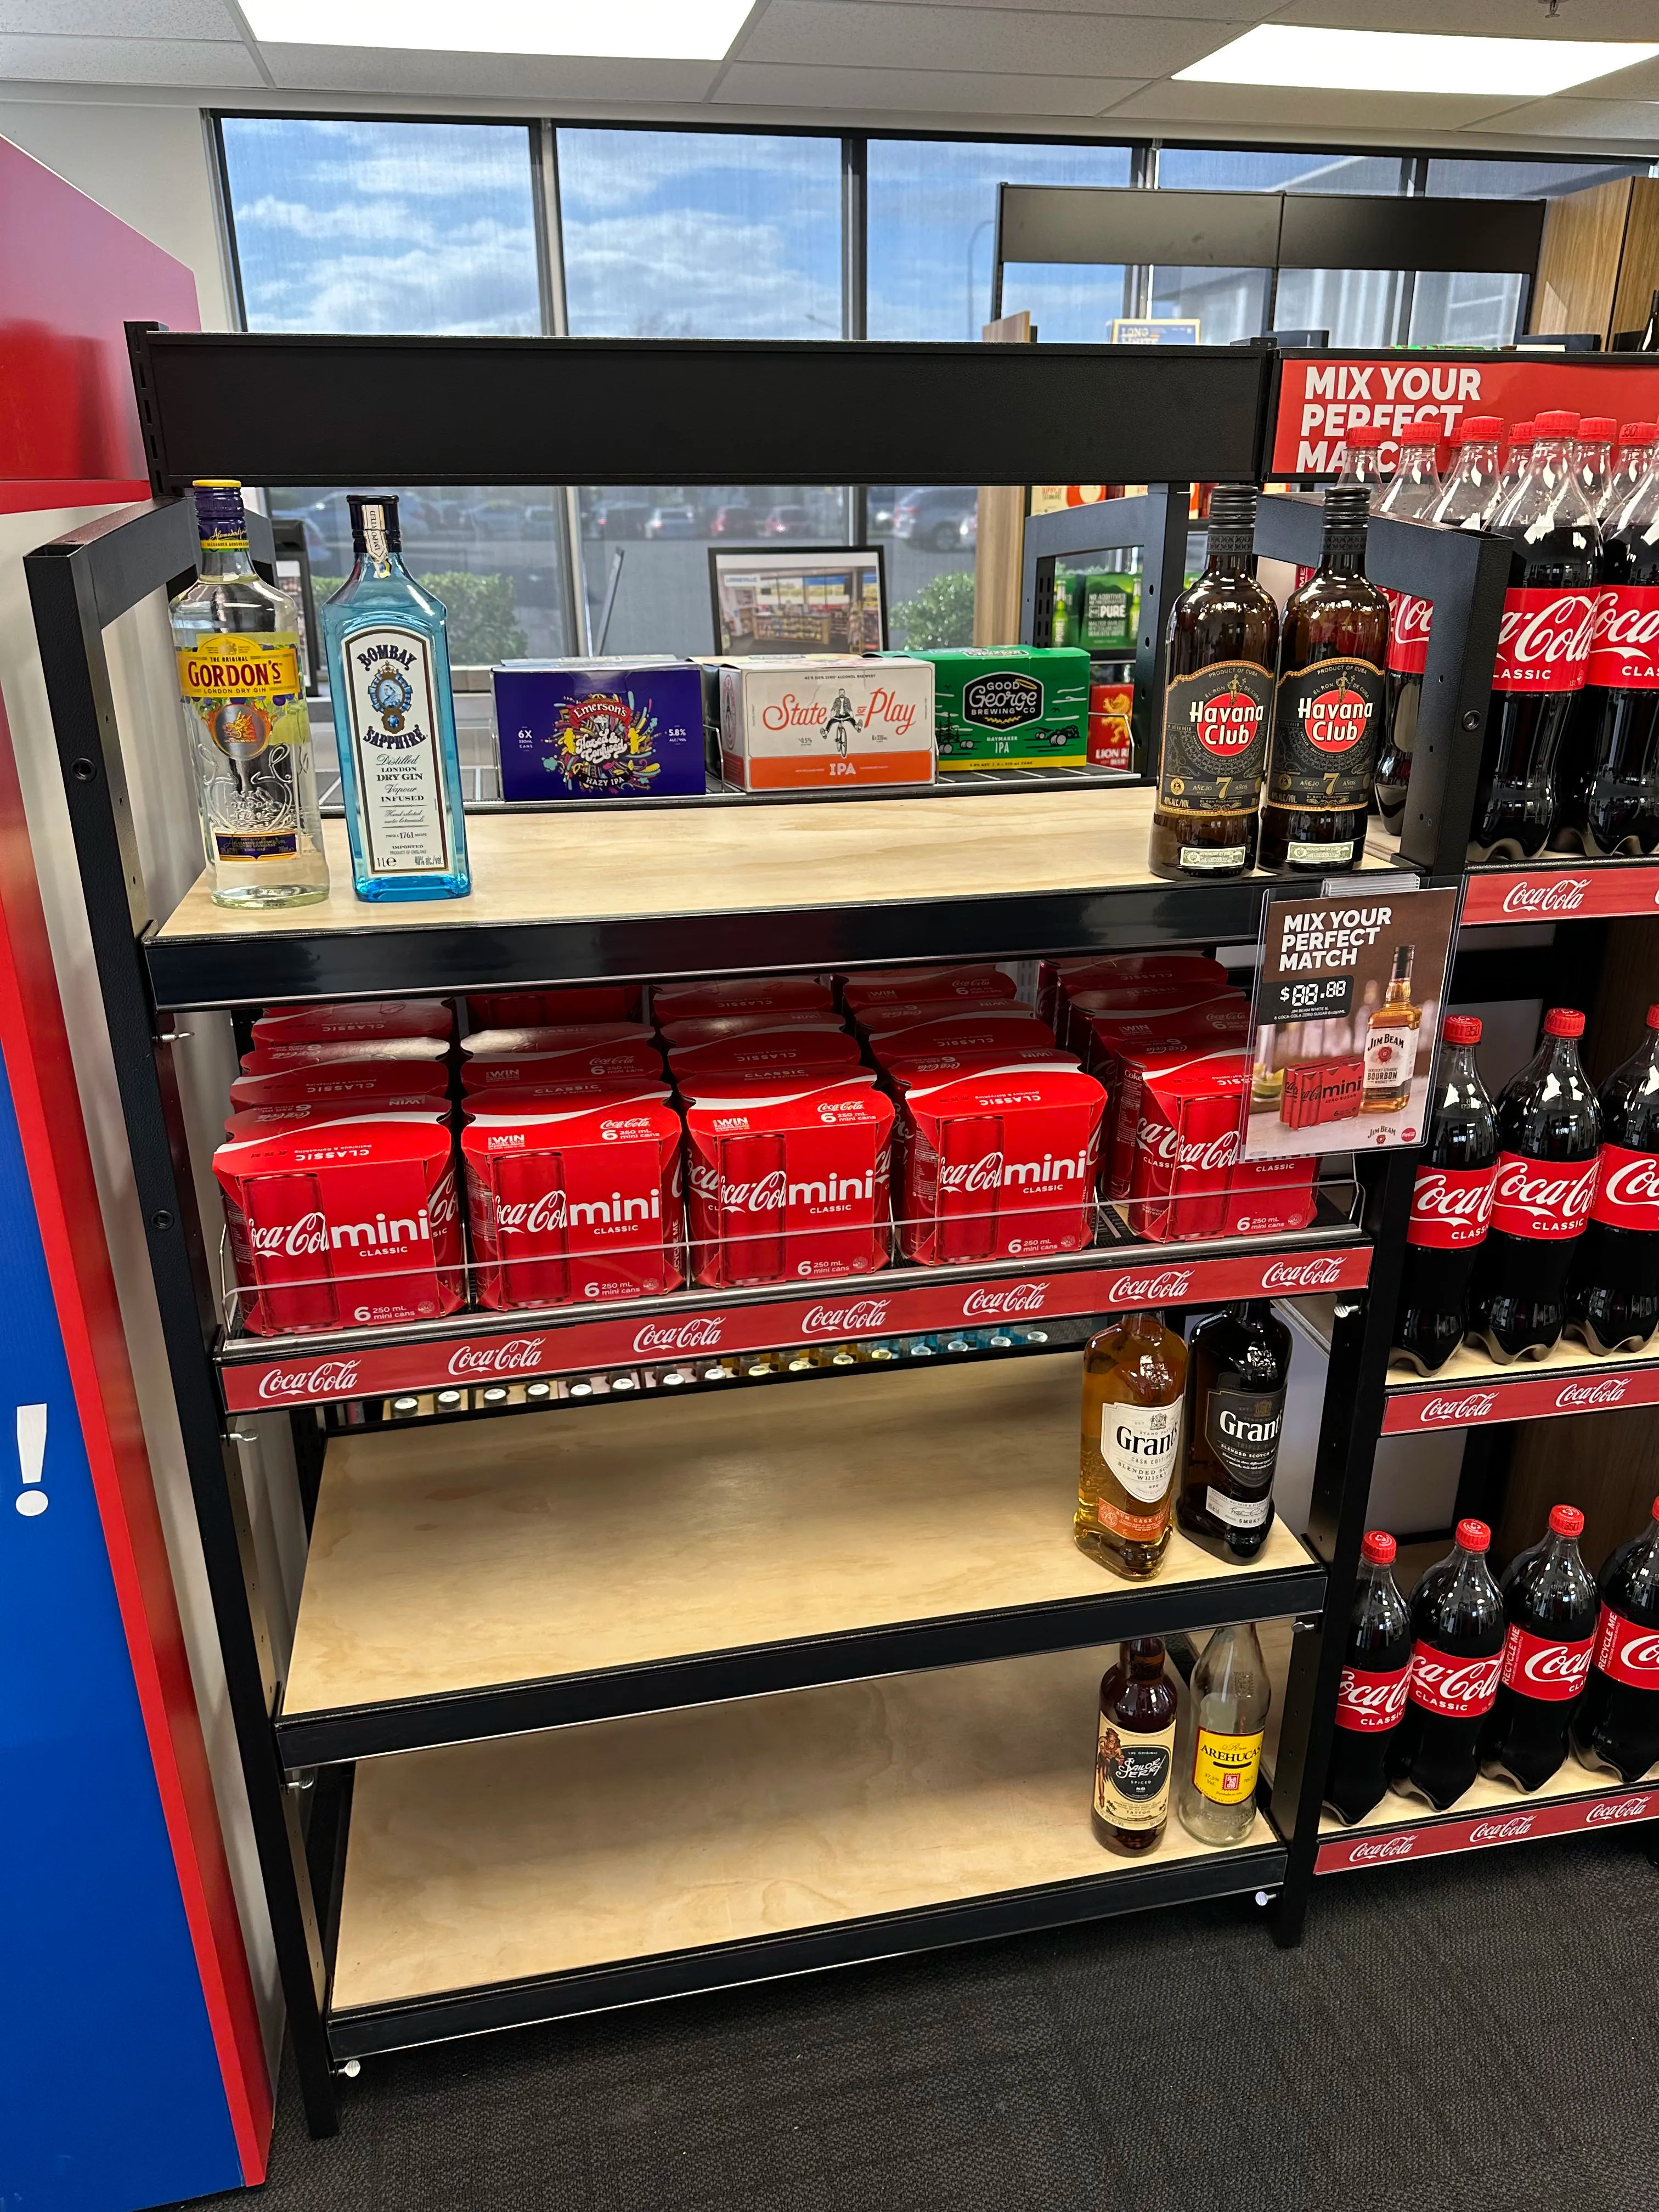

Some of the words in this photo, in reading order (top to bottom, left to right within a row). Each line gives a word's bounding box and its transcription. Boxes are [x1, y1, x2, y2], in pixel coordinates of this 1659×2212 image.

[1305, 366, 1374, 400] MIX
[1380, 367, 1481, 400] YOUR
[1099, 605, 1127, 618] PURE
[357, 645, 417, 671] BOMBAY
[188, 660, 282, 687] GORDON'S
[1209, 668, 1235, 678] PRODUCT
[1245, 668, 1258, 677] CUBA
[1317, 665, 1344, 675] PRODUCT
[1354, 666, 1367, 674] CUBA
[987, 682, 1020, 691] GOOD
[1212, 685, 1226, 693] RON
[1359, 686, 1369, 698] CUBA
[969, 685, 1037, 711] George
[573, 702, 628, 719] Emerson's
[763, 694, 827, 731] State
[864, 687, 917, 735] Play
[1189, 701, 1264, 724] Havana
[1297, 697, 1373, 719] Havana
[363, 724, 426, 750] SAPPHIRE
[518, 730, 532, 738] 6X
[1204, 724, 1250, 745] Club
[1312, 720, 1358, 741] Club
[575, 728, 610, 754] Hazed
[995, 742, 1009, 754] IPA
[376, 754, 420, 766] Distilled
[580, 740, 628, 764] Confused
[1096, 748, 1119, 759] LION
[829, 762, 856, 776] IPA
[385, 783, 417, 795] Vapour
[586, 776, 609, 786] HAZY
[611, 776, 625, 786] IPA
[1216, 776, 1233, 800] 7
[1323, 772, 1341, 795] 7
[1503, 879, 1593, 913] Coca-Cola
[1283, 912, 1328, 934] MIX
[1330, 906, 1392, 931] YOUR
[1281, 927, 1381, 953] PERFECT
[1279, 947, 1358, 972] MATCH
[1279, 980, 1347, 1007] $88.88
[1367, 1036, 1384, 1051] JIM
[1384, 1034, 1404, 1048] BEAM
[1125, 1069, 1143, 1080] Coke
[1367, 1071, 1398, 1081] BOURBON
[1322, 1076, 1362, 1098] mini
[979, 1095, 1041, 1106] CLASSIC
[1368, 1128, 1380, 1139] JIM
[1380, 1125, 1396, 1136] BEAM
[295, 1149, 370, 1161] CLASSIC
[1003, 1149, 1087, 1186] mini
[1255, 1163, 1295, 1172] CLASSIC
[789, 1169, 874, 1205] mini
[1023, 1184, 1064, 1194] CLASSIC
[571, 1188, 659, 1227] mini
[809, 1204, 852, 1214] CLASSIC
[331, 1209, 430, 1249] mini
[594, 1224, 639, 1235] CLASSIC
[1236, 1216, 1250, 1231] 6
[1532, 1217, 1584, 1231] CLASSIC
[359, 1246, 408, 1257] CLASSIC
[1008, 1239, 1022, 1254] 6
[797, 1261, 811, 1276] 6
[584, 1282, 600, 1297] 6
[354, 1306, 371, 1321] 6
[258, 1359, 361, 1398] Coca-Cola
[447, 1337, 546, 1375] Coca-Cola
[633, 1316, 726, 1353] Coca-Cola
[802, 1299, 891, 1334] Coca-Cola
[963, 1282, 1051, 1316] Coca-Cola
[1109, 1269, 1195, 1302] Coca-Cola
[1261, 1257, 1347, 1289] Coca-Cola
[1420, 1391, 1499, 1422] Coca-Cola
[1555, 1378, 1633, 1408] Coca-Cola
[1221, 1443, 1247, 1457] BLENDED
[1118, 1461, 1156, 1475] BLENDED
[1598, 1628, 1614, 1671] RECYCLE
[1610, 1611, 1617, 1630] ME
[1500, 1643, 1516, 1685] RECYCLE
[1512, 1626, 1520, 1644] ME
[1415, 1689, 1469, 1711] CLASSIC
[1360, 1708, 1403, 1726] CLASSIC
[1349, 1835, 1418, 1863] Coca-Cola
[1469, 1814, 1537, 1843] Coca-Cola
[1586, 1795, 1652, 1823] Coca-Cola
